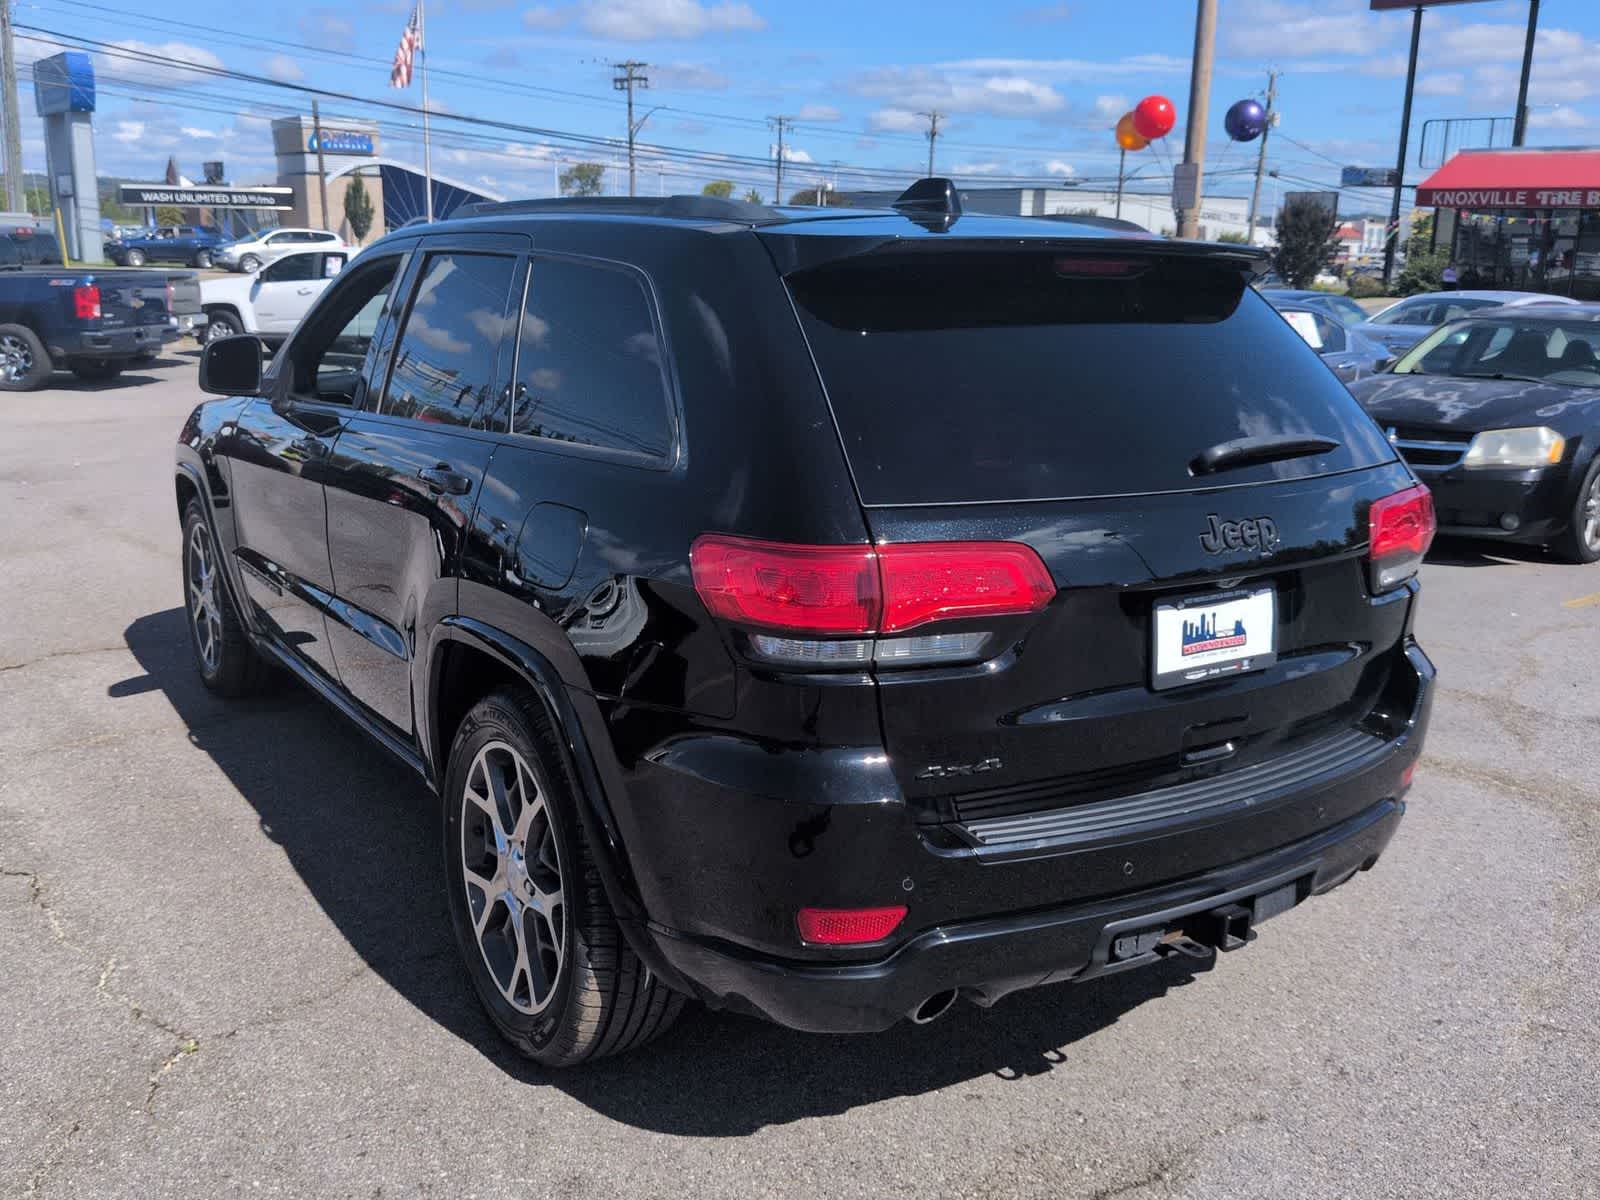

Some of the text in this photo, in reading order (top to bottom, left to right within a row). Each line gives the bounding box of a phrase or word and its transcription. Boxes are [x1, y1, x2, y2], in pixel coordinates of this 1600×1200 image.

[141, 191, 173, 202] WASH
[175, 192, 230, 203] UNLIMITED
[1431, 191, 1527, 205] KNOXVILLE
[1199, 513, 1280, 556] Jeep
